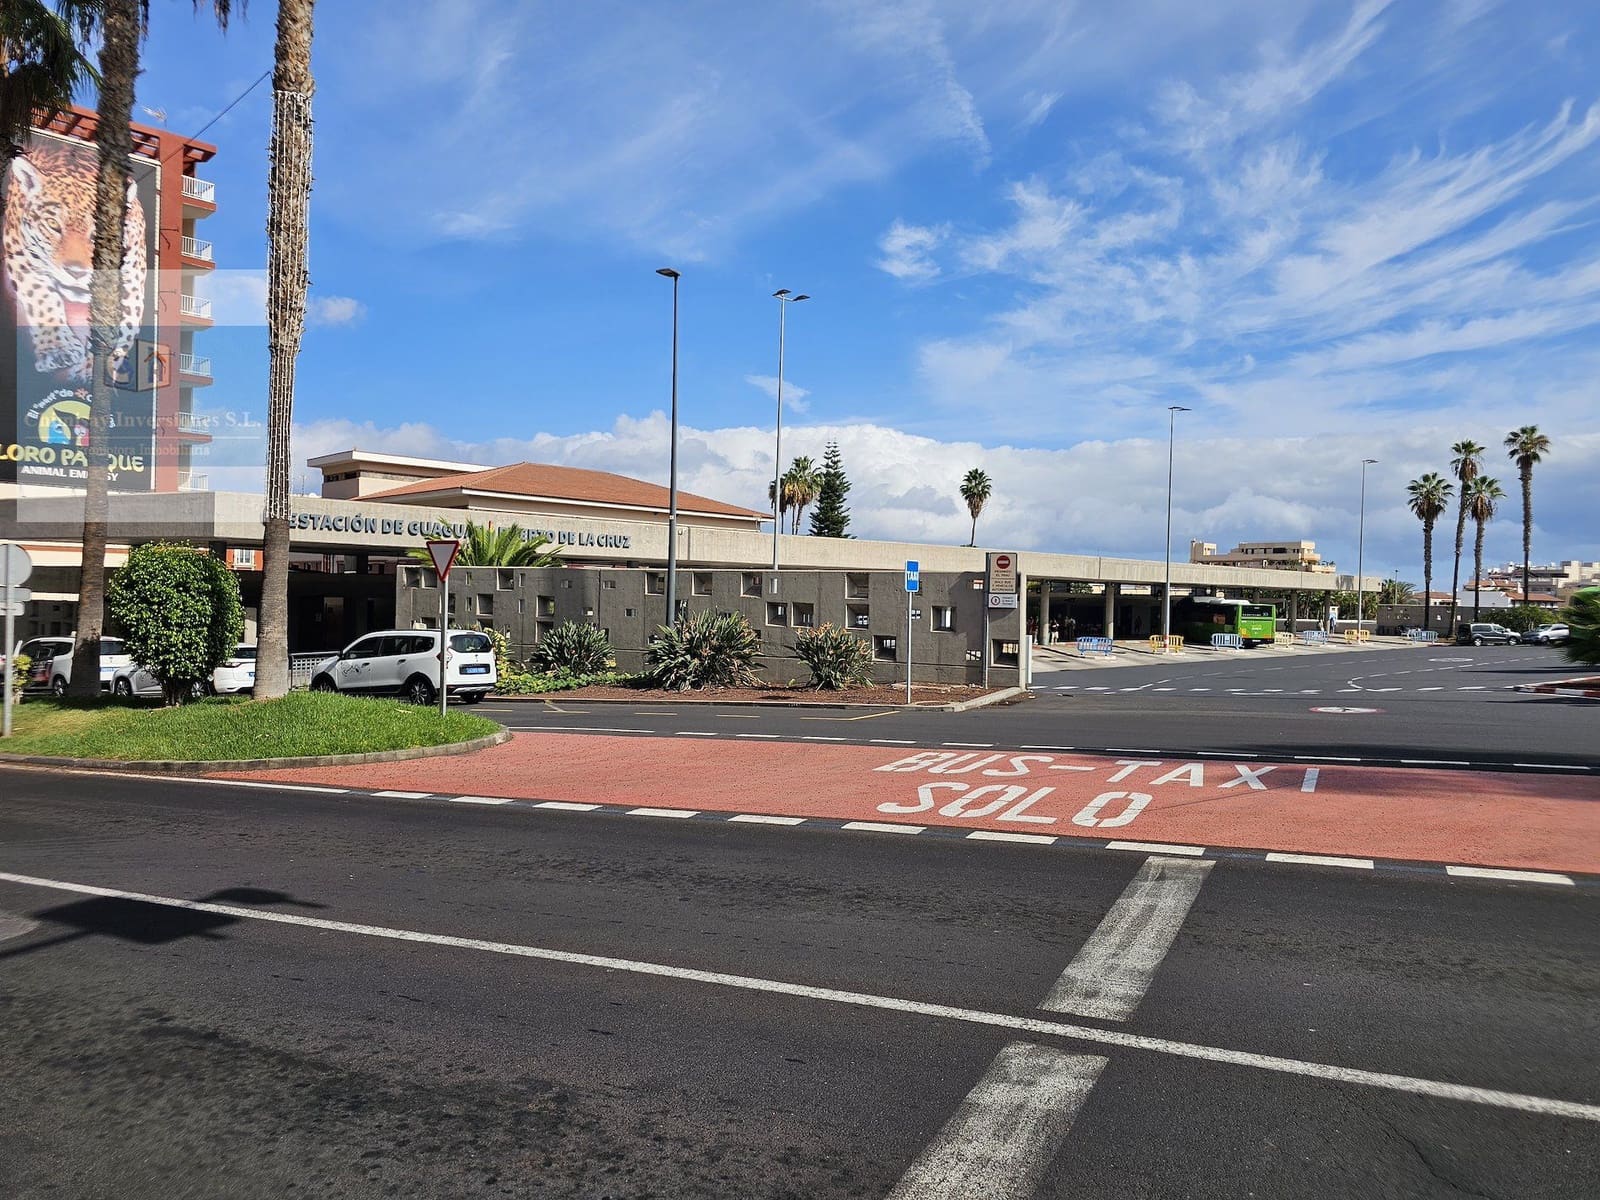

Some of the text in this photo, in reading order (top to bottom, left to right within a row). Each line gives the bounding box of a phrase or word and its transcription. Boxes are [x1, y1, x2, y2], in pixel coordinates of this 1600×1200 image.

[0, 443, 144, 473] LORO PAQUE
[21, 465, 119, 481] ANIMAL EMSY
[289, 513, 377, 533] ESTACIÓN
[381, 518, 404, 535] DE
[558, 530, 576, 546] DE
[579, 532, 595, 547] LA
[597, 533, 631, 549] CRUZ
[876, 781, 1153, 828] SOLO
